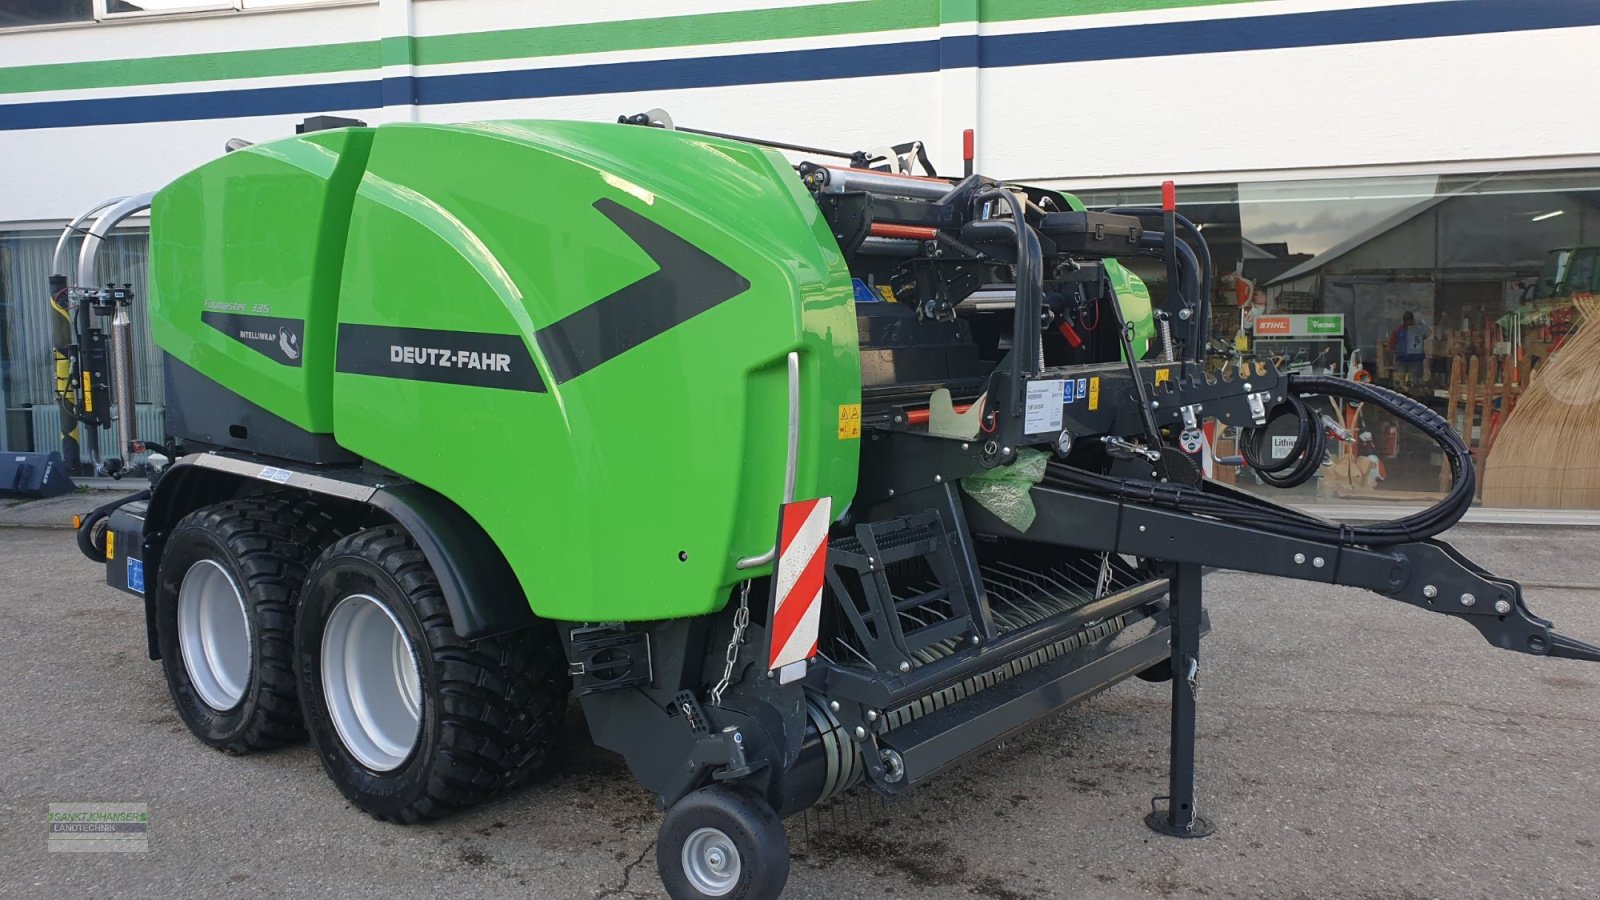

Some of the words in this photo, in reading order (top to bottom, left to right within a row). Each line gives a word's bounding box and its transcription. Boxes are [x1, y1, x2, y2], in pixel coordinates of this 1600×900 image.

[1259, 321, 1287, 329] STIHL
[1311, 320, 1337, 328] VIKING
[239, 331, 276, 341] INTELLIWRAP
[390, 345, 511, 372] DEUTZ-FAHR
